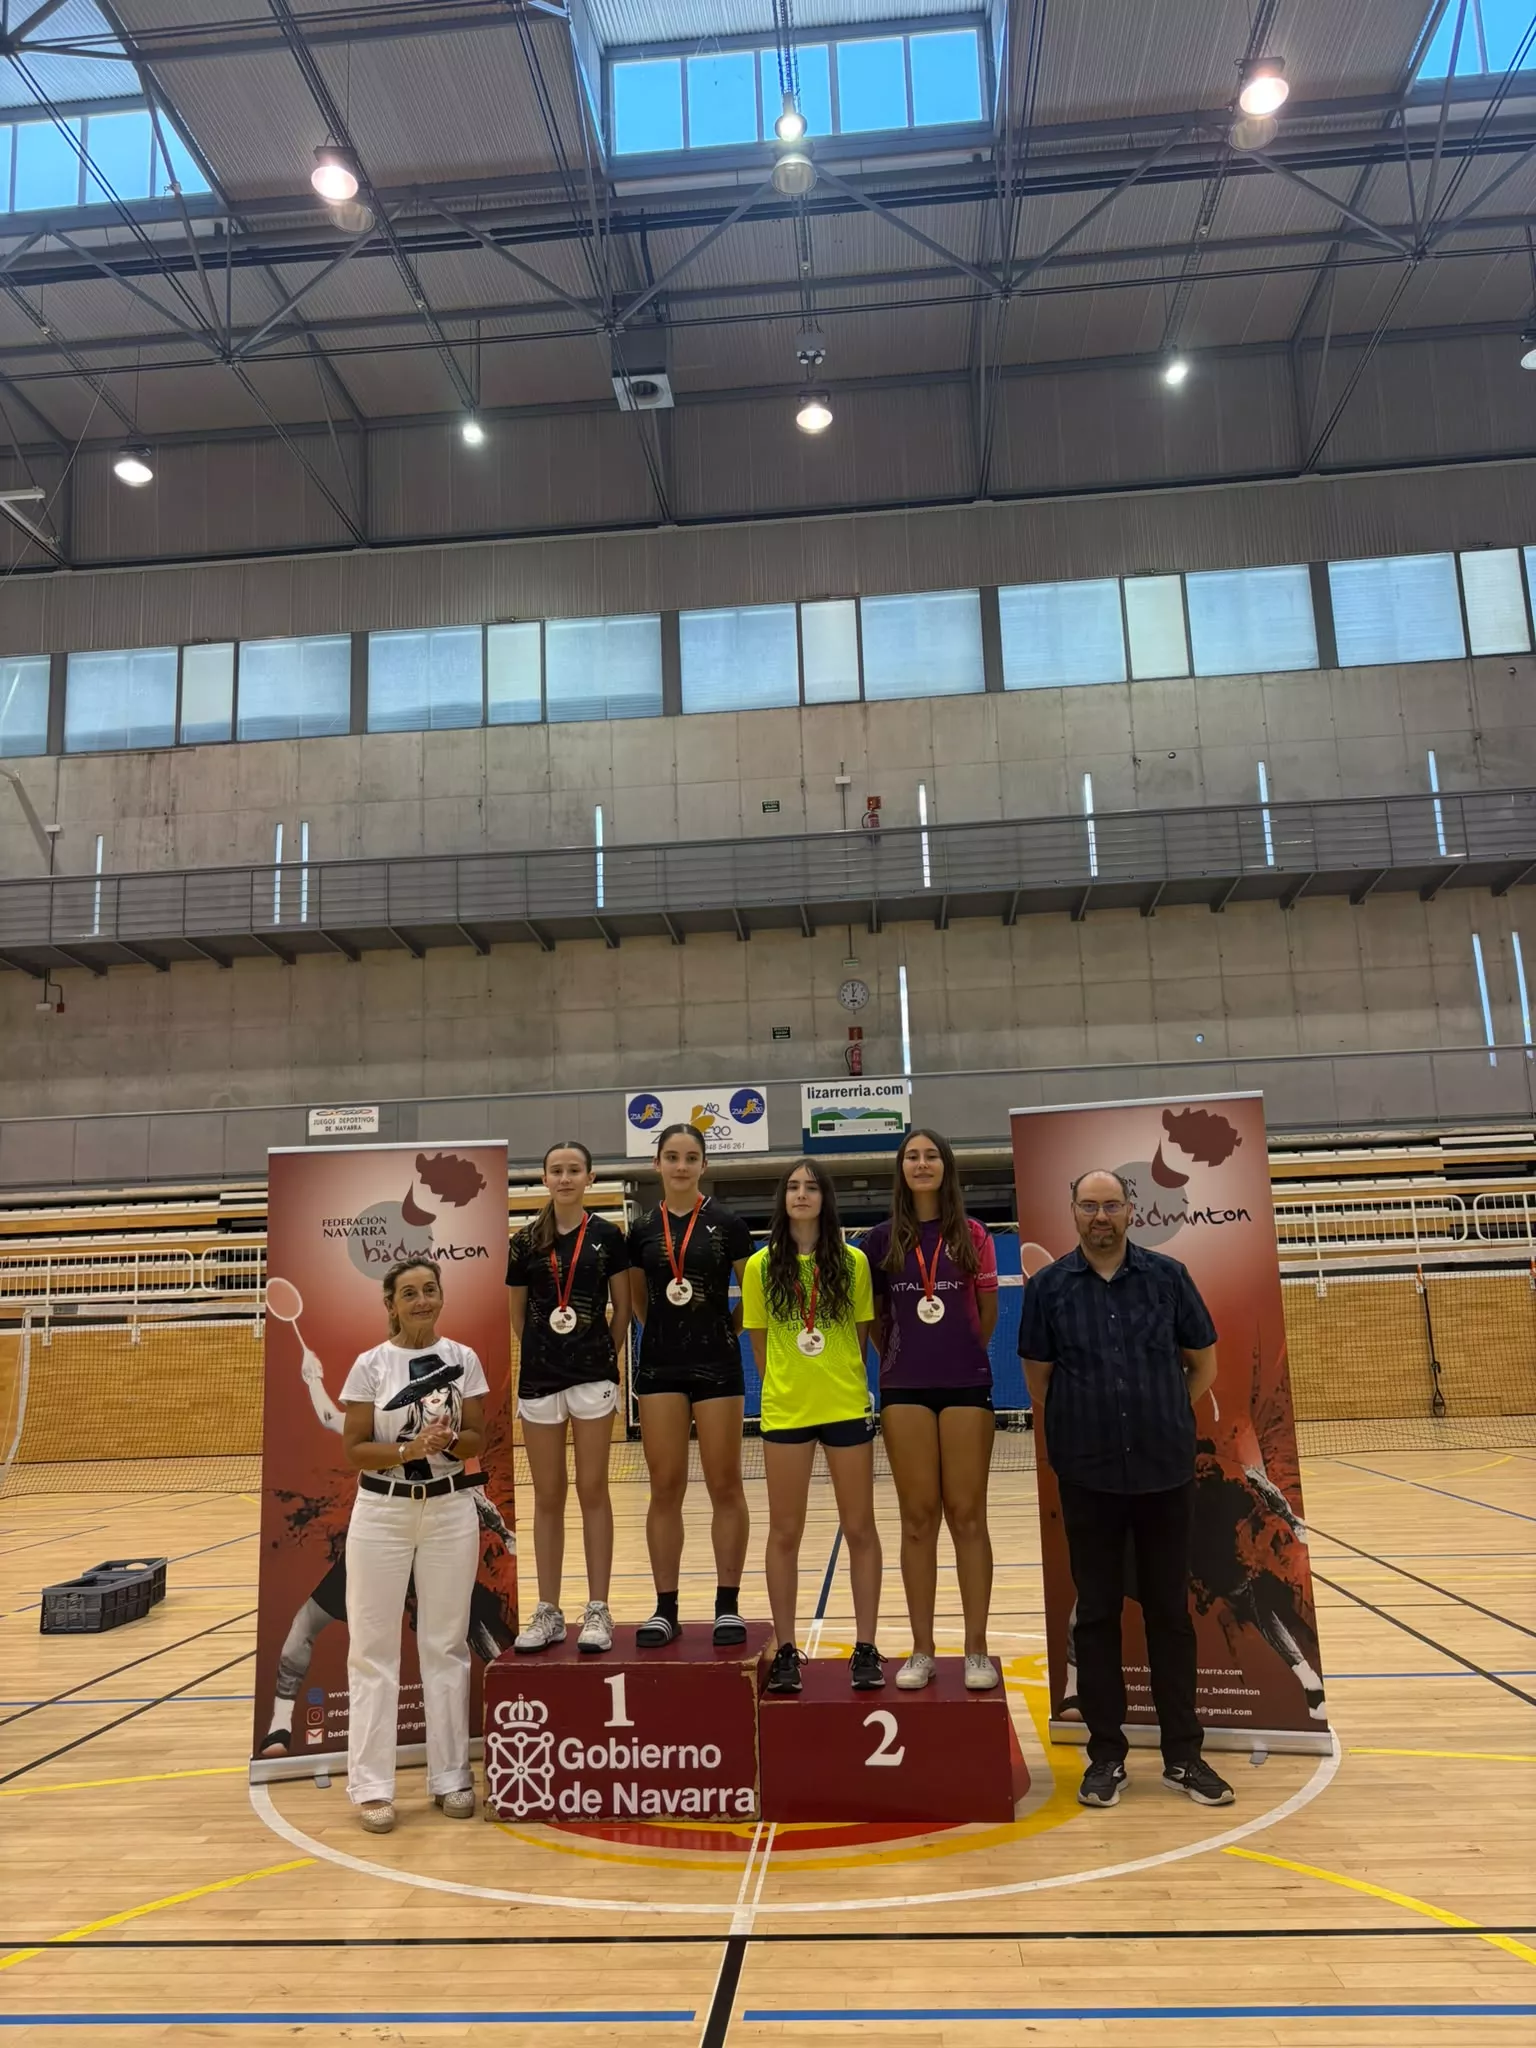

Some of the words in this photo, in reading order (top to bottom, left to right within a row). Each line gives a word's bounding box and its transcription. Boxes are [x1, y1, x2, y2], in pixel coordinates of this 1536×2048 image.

[807, 1084, 903, 1099] lizarrerria.com
[339, 1116, 375, 1124] DEPORTIVOS
[718, 1142, 731, 1150] 546
[322, 1216, 387, 1228] FEDERACIÓN
[323, 1226, 387, 1238] NAVARRA
[375, 1239, 386, 1247] DE
[604, 1672, 635, 1728] 1
[863, 1710, 906, 1766] 2
[558, 1737, 721, 1769] Gobierno
[559, 1781, 602, 1814] de
[613, 1782, 756, 1814] Navarra
